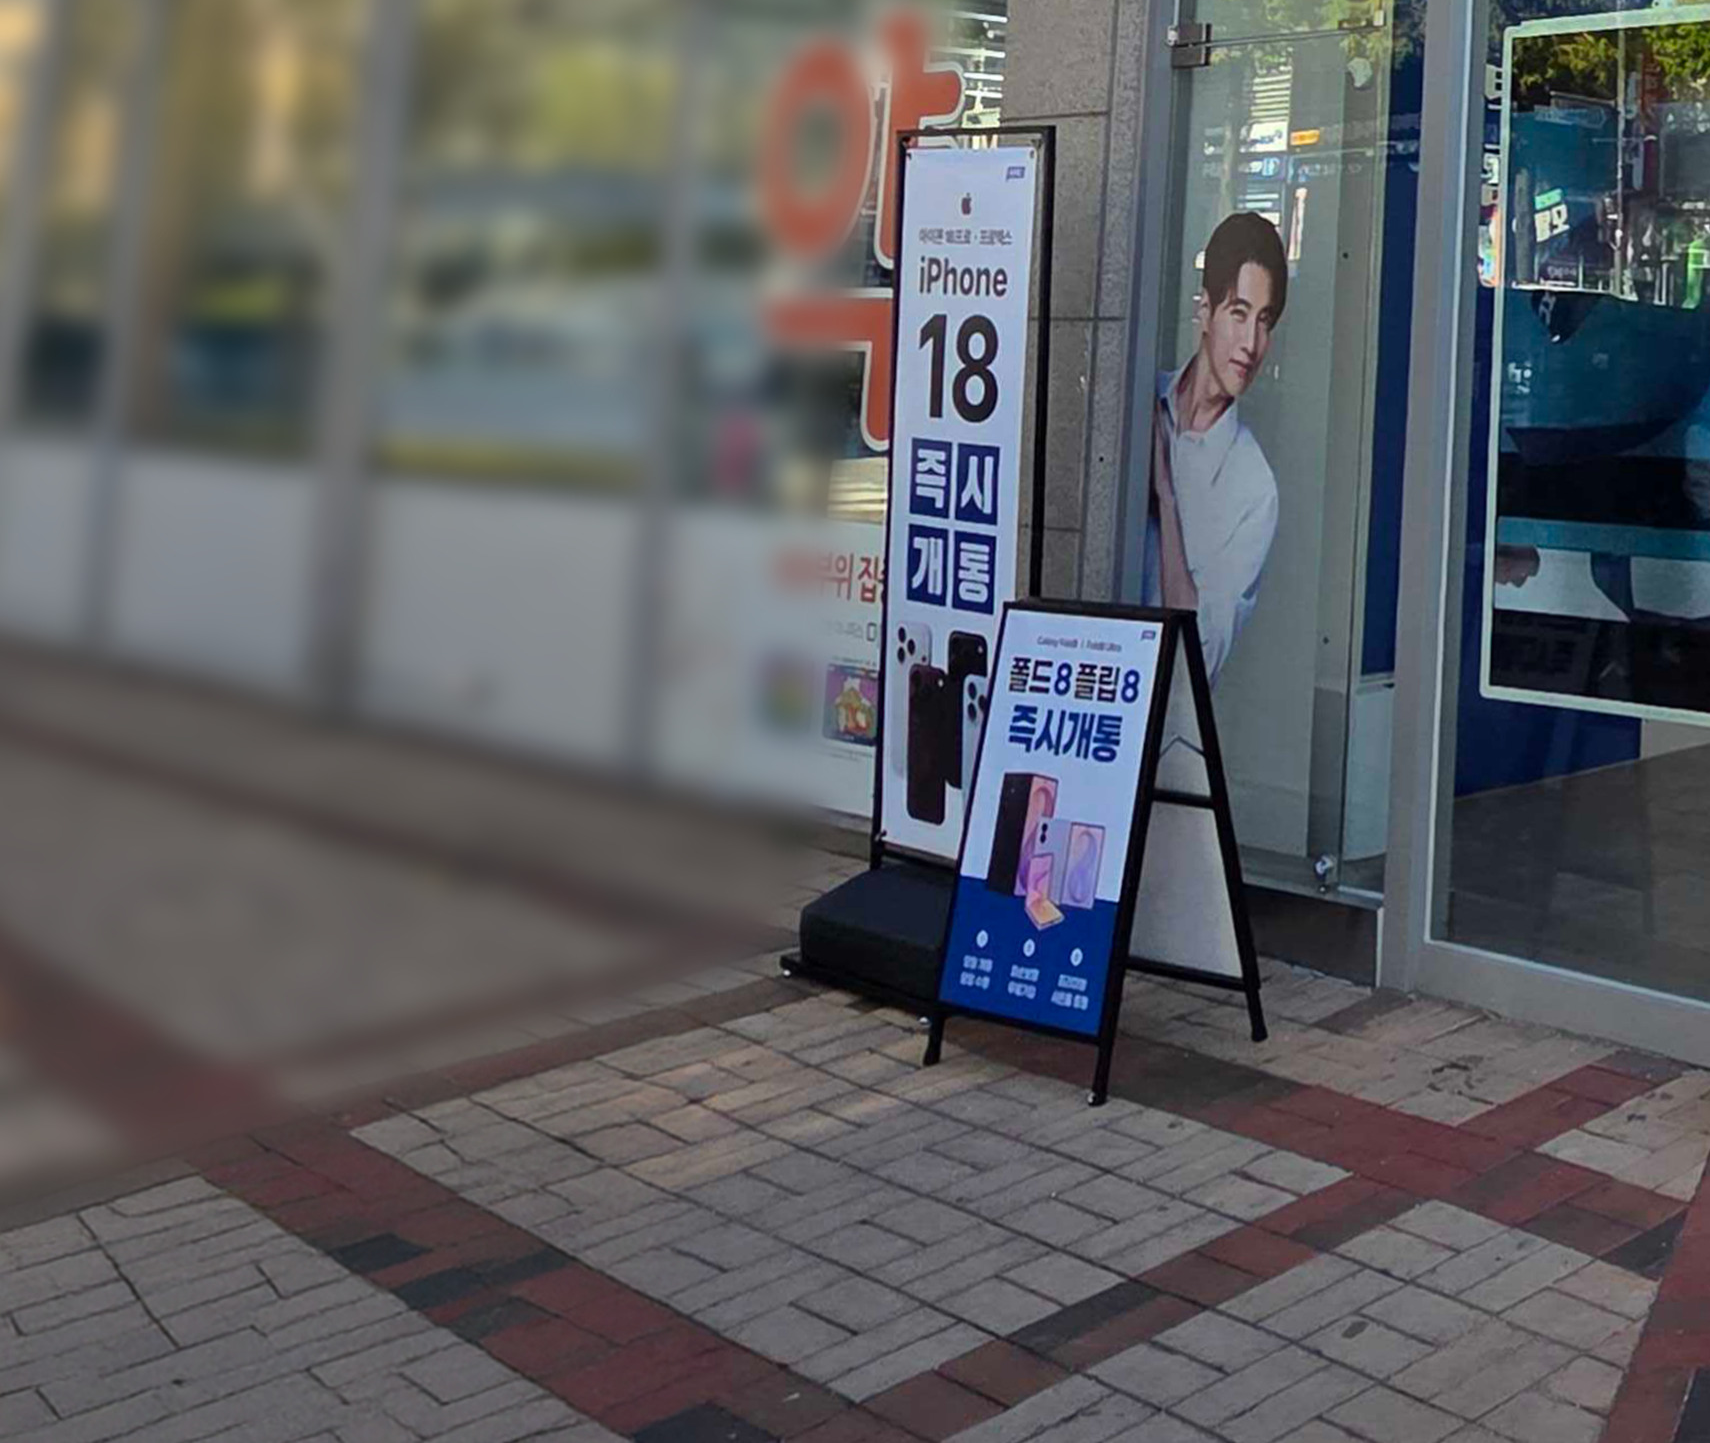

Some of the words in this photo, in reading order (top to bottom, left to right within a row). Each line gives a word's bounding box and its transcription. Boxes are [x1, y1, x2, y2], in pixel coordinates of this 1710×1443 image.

[919, 256, 1008, 297] iPhone
[918, 313, 999, 424] 18
[914, 447, 996, 515] 즉시
[909, 533, 993, 613] 개통
[1008, 656, 1073, 696] 폴드8
[1074, 662, 1141, 704] 플립8
[1008, 704, 1123, 763] 즉시개통
